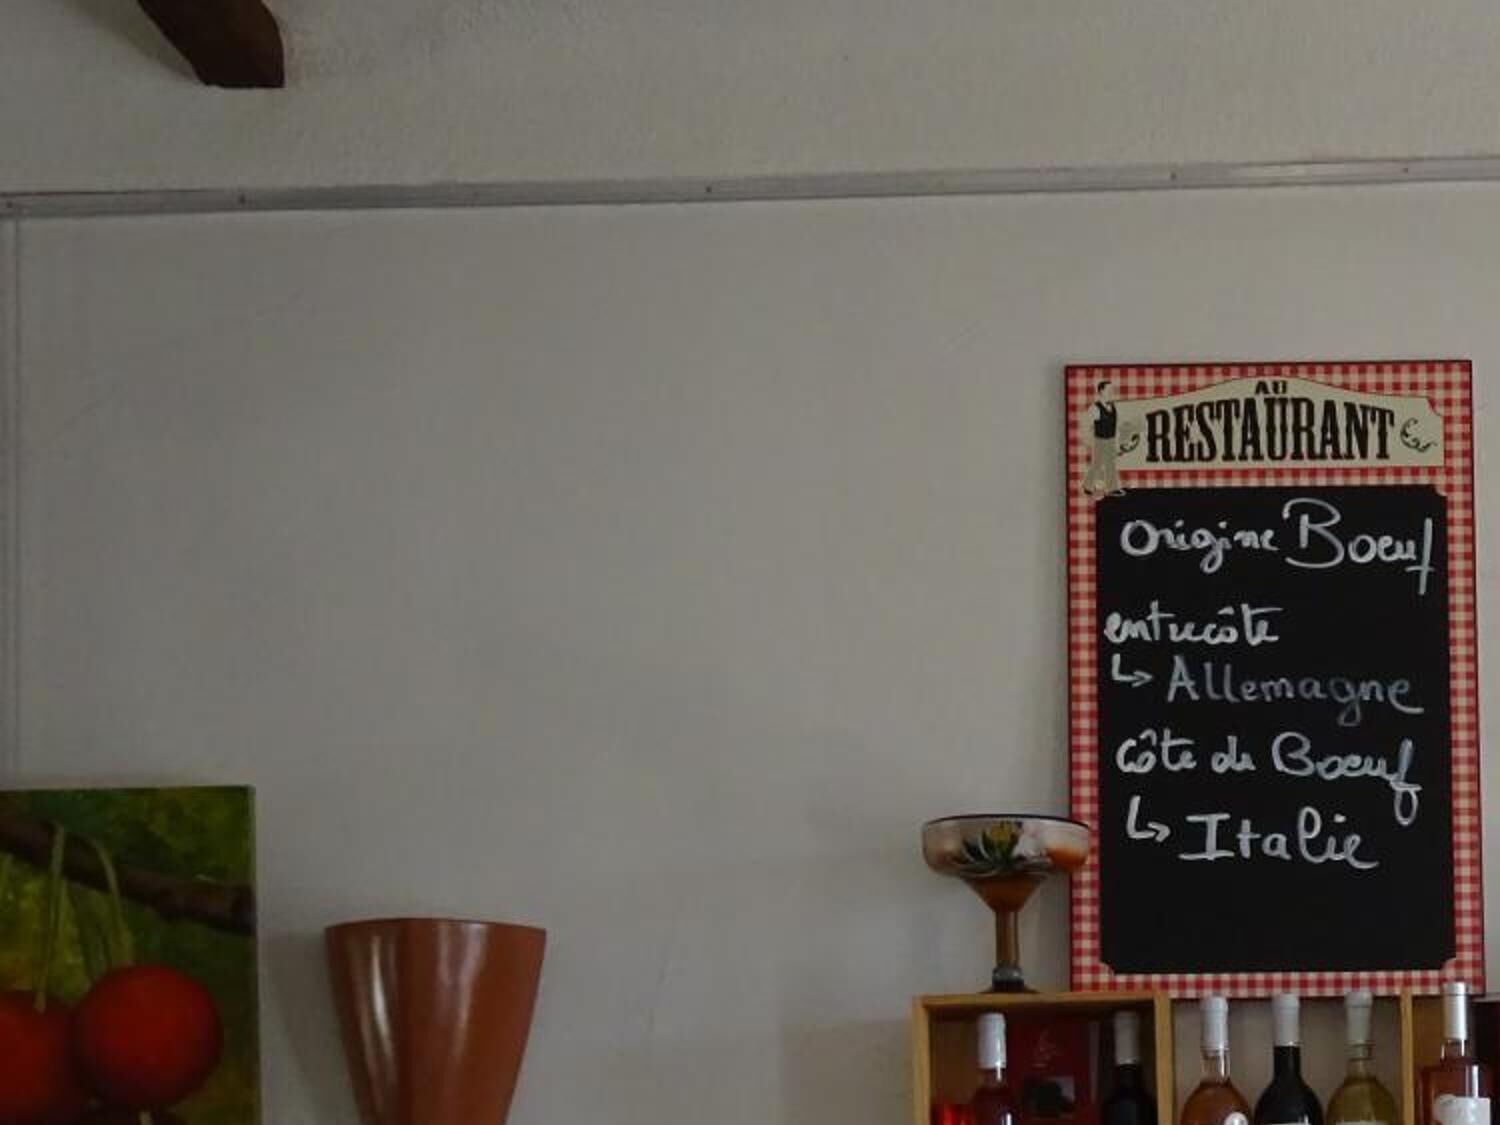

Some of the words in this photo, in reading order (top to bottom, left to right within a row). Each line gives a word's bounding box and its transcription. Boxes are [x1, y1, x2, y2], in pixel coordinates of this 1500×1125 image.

[1254, 380, 1287, 394] AU
[1145, 397, 1395, 462] RESTAURANT
[1120, 519, 1278, 574] Origine
[1167, 655, 1425, 726] Allemagne
[1210, 734, 1256, 774] de
[1178, 806, 1380, 870] Italie
